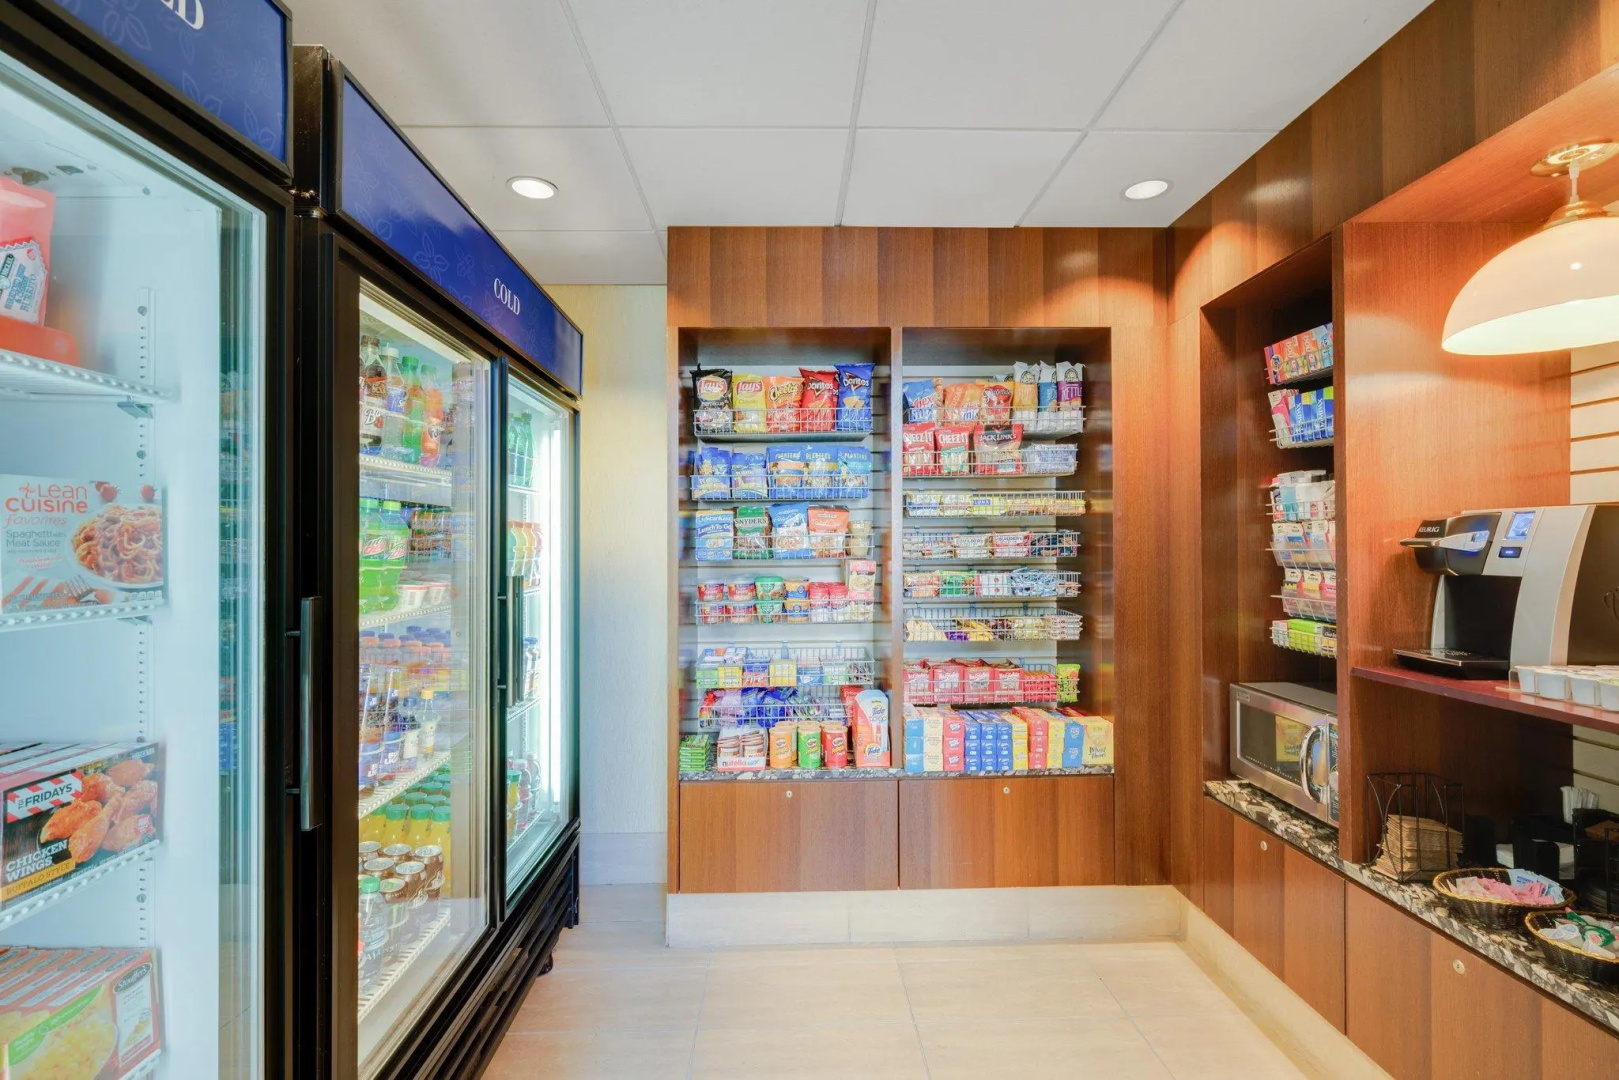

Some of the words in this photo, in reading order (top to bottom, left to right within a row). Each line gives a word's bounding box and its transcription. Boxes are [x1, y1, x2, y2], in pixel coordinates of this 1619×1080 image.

[493, 277, 520, 316] COLD
[807, 381, 834, 390] Doritos
[842, 377, 870, 387] Doritos
[769, 381, 798, 401] Cheetos
[37, 484, 88, 499] Lean
[6, 530, 52, 539] Spaghetti
[6, 539, 31, 547] Meat
[32, 539, 60, 547] Sauce
[25, 783, 73, 807] FRIDAYS
[5, 839, 68, 873] CHICKEN
[6, 856, 53, 883] WINGS
